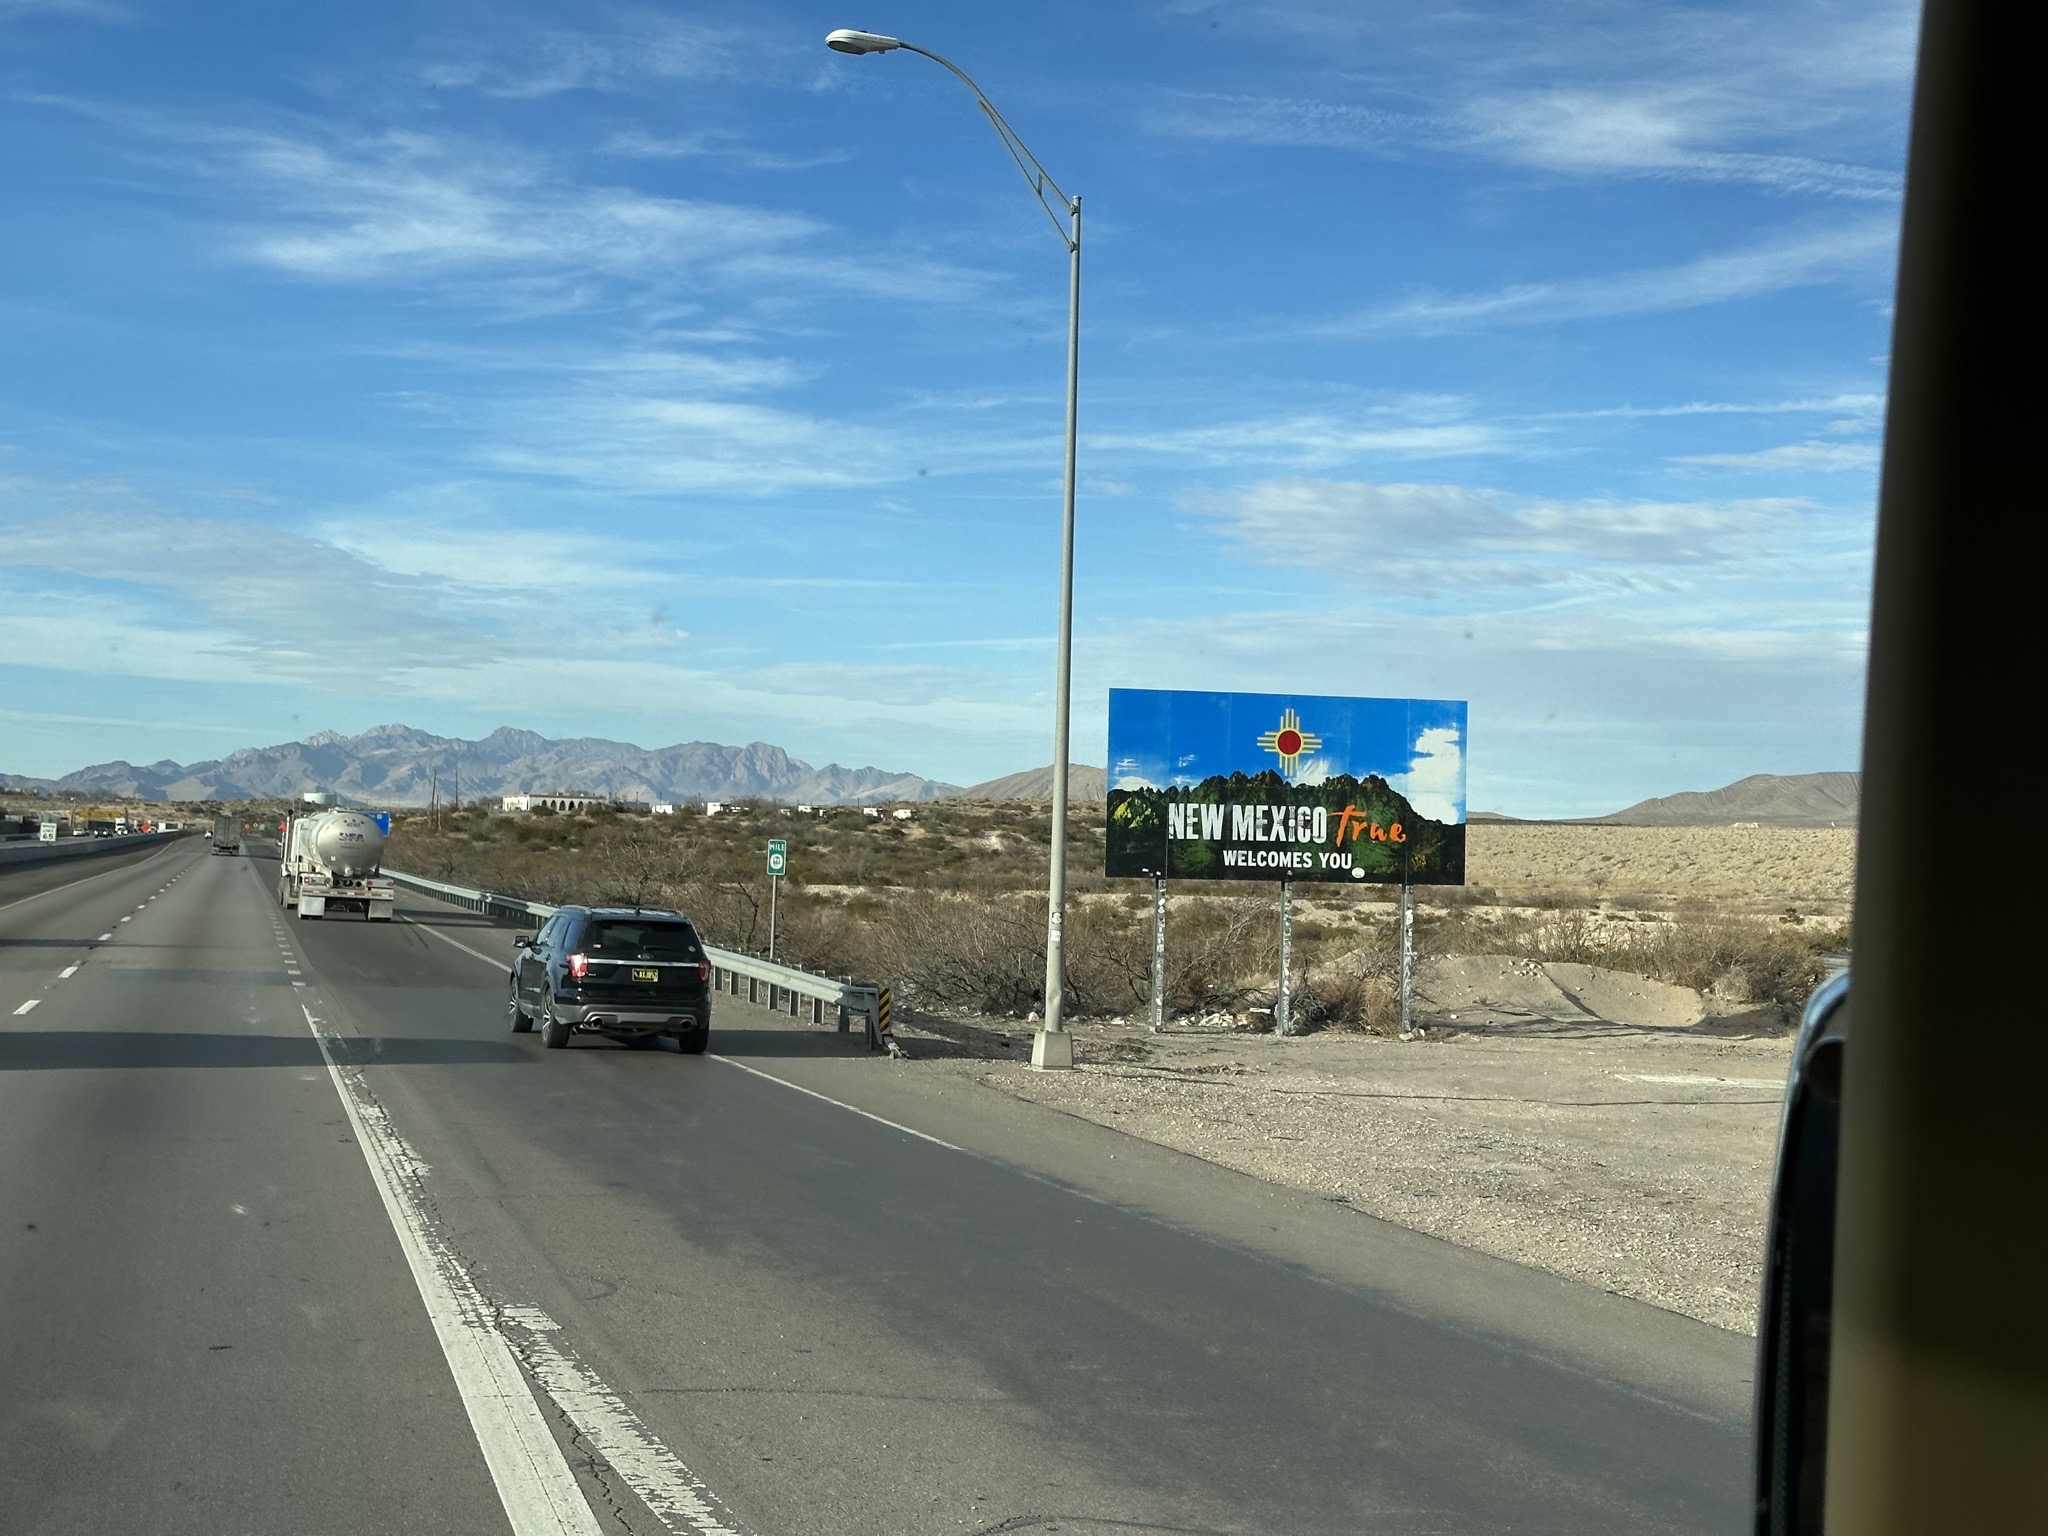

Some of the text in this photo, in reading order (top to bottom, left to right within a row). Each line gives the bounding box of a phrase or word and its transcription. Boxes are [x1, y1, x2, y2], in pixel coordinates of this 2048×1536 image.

[1168, 803, 1225, 840] NEW
[1232, 805, 1327, 844] MEXICO
[770, 843, 785, 851] MILE
[1222, 850, 1352, 870] WELCOMES YOU
